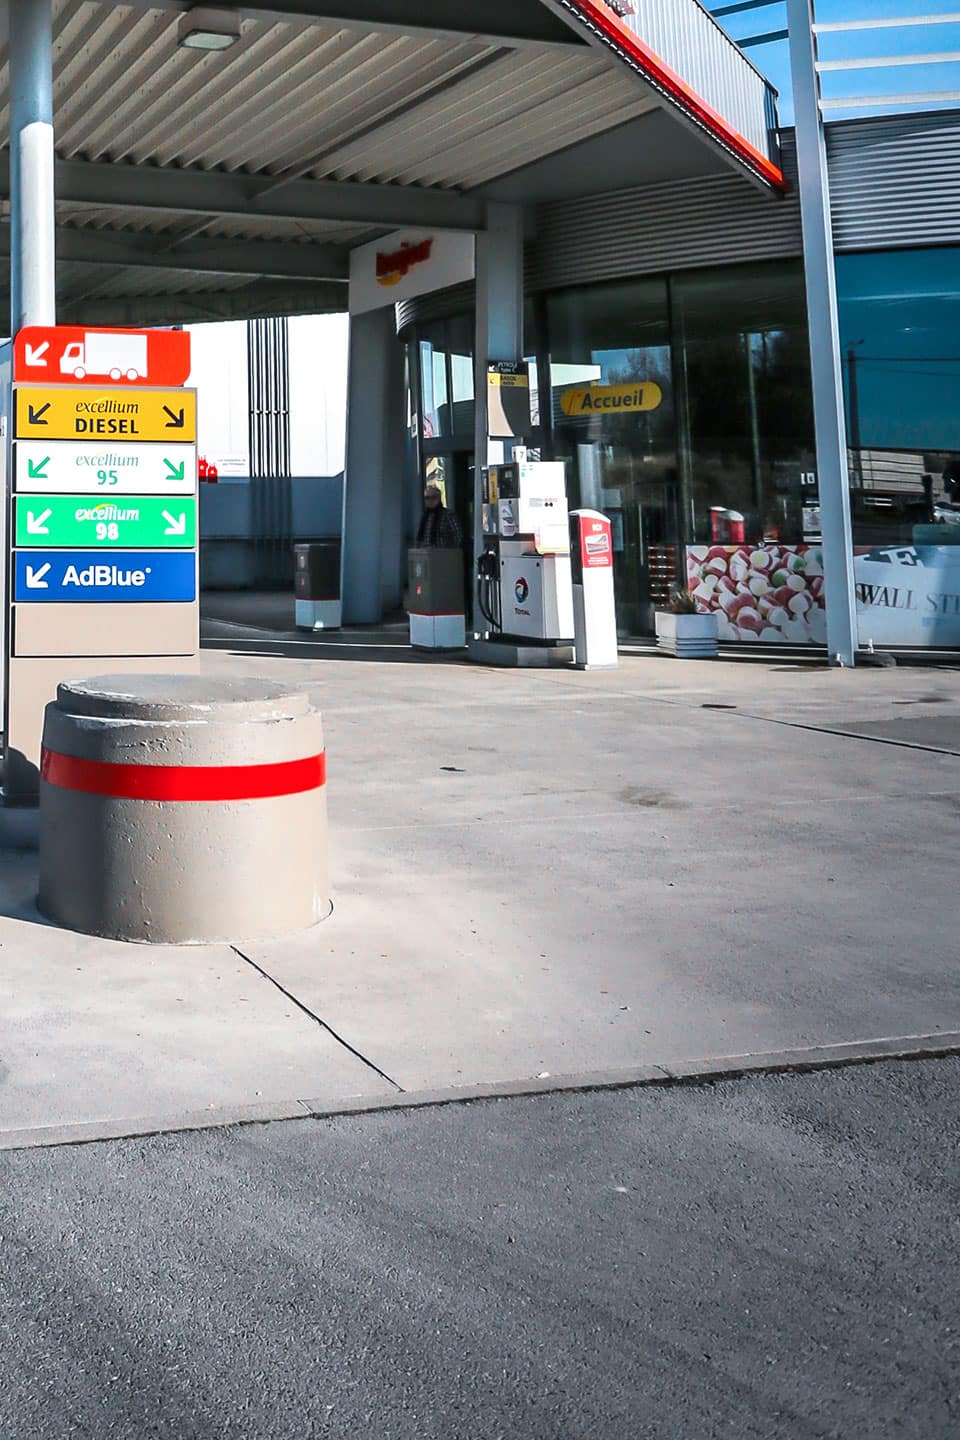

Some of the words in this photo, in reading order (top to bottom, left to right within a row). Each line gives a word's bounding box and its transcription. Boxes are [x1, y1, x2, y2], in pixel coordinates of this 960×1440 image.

[75, 400, 139, 414] excellium
[581, 389, 644, 409] Accueil
[75, 418, 139, 434] DIESEL
[75, 453, 138, 467] excellium
[97, 470, 118, 485] 95
[75, 505, 139, 521] excellium
[96, 522, 119, 540] 98
